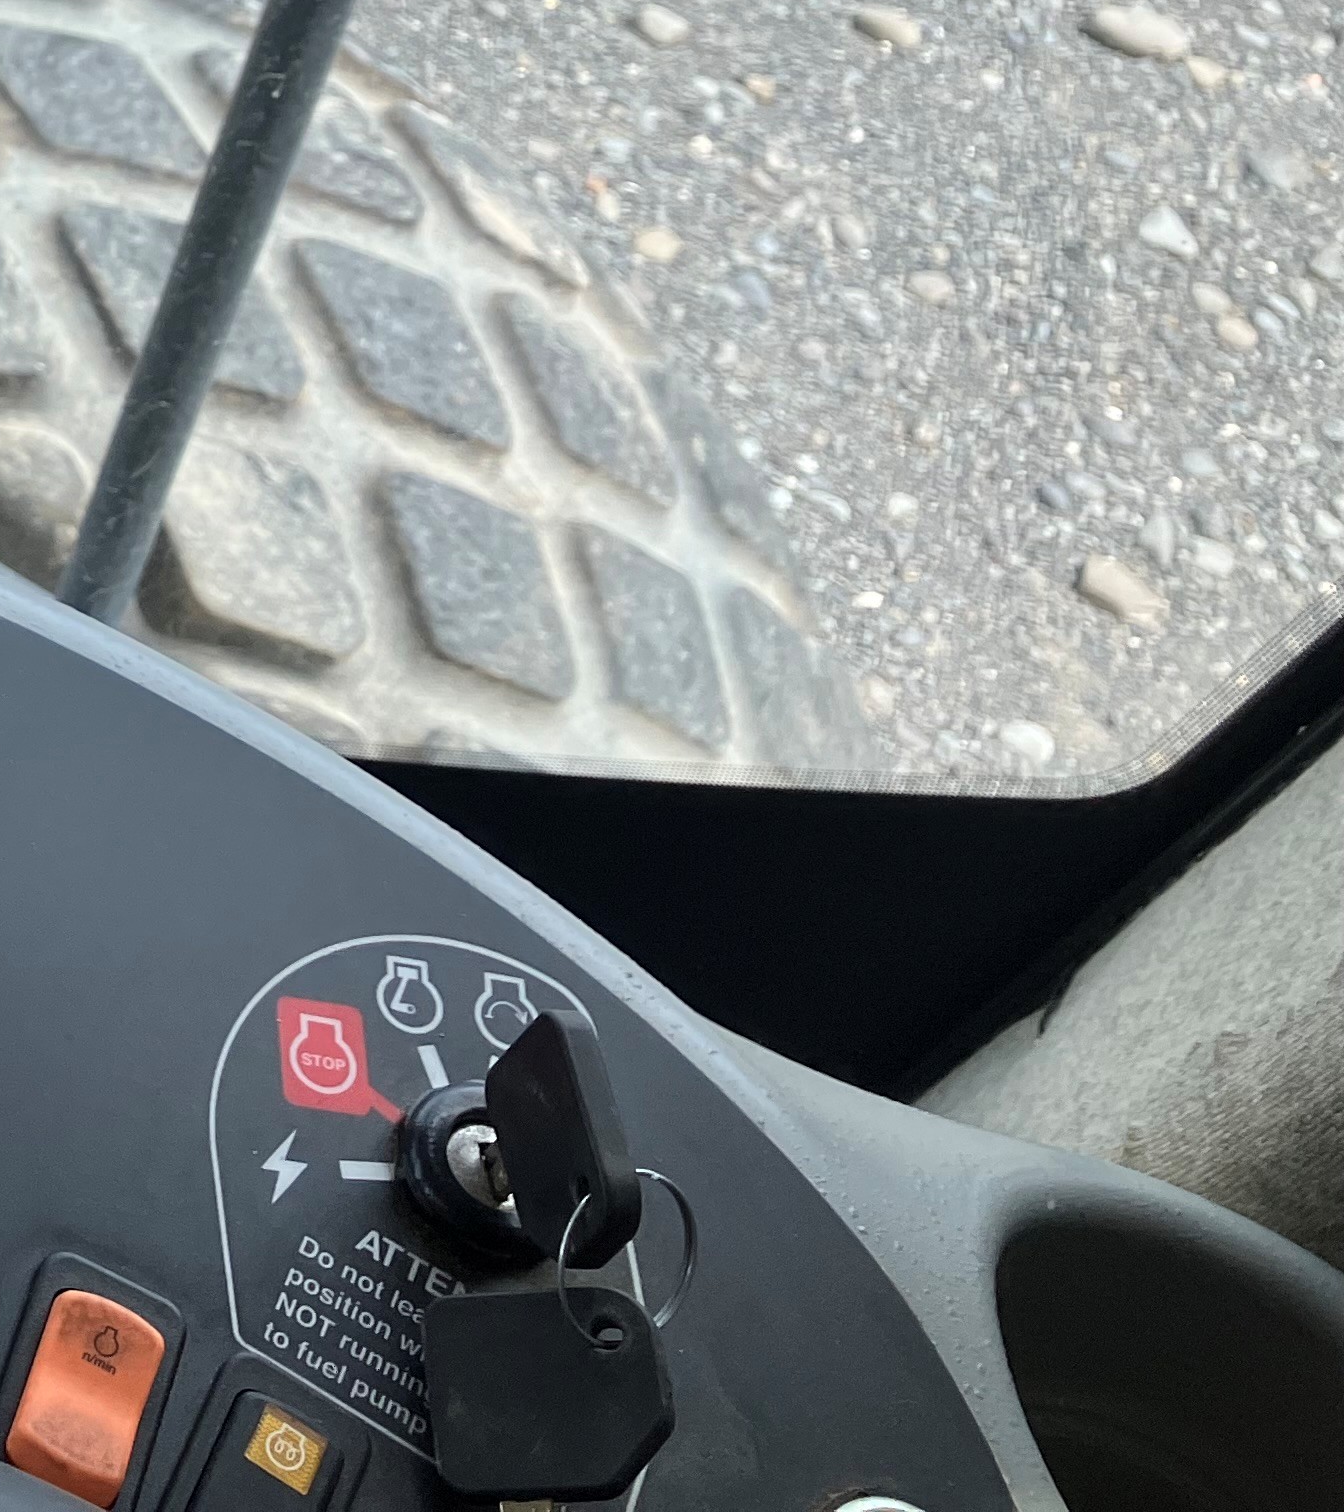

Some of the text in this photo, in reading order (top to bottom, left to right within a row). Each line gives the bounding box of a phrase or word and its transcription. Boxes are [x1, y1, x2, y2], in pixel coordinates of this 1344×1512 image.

[300, 1052, 347, 1071] STOP
[298, 1235, 334, 1269] Do
[340, 1265, 384, 1300] not
[274, 1291, 336, 1338] NOT
[283, 1267, 391, 1340] position
[263, 1321, 428, 1435] to fuel pump
